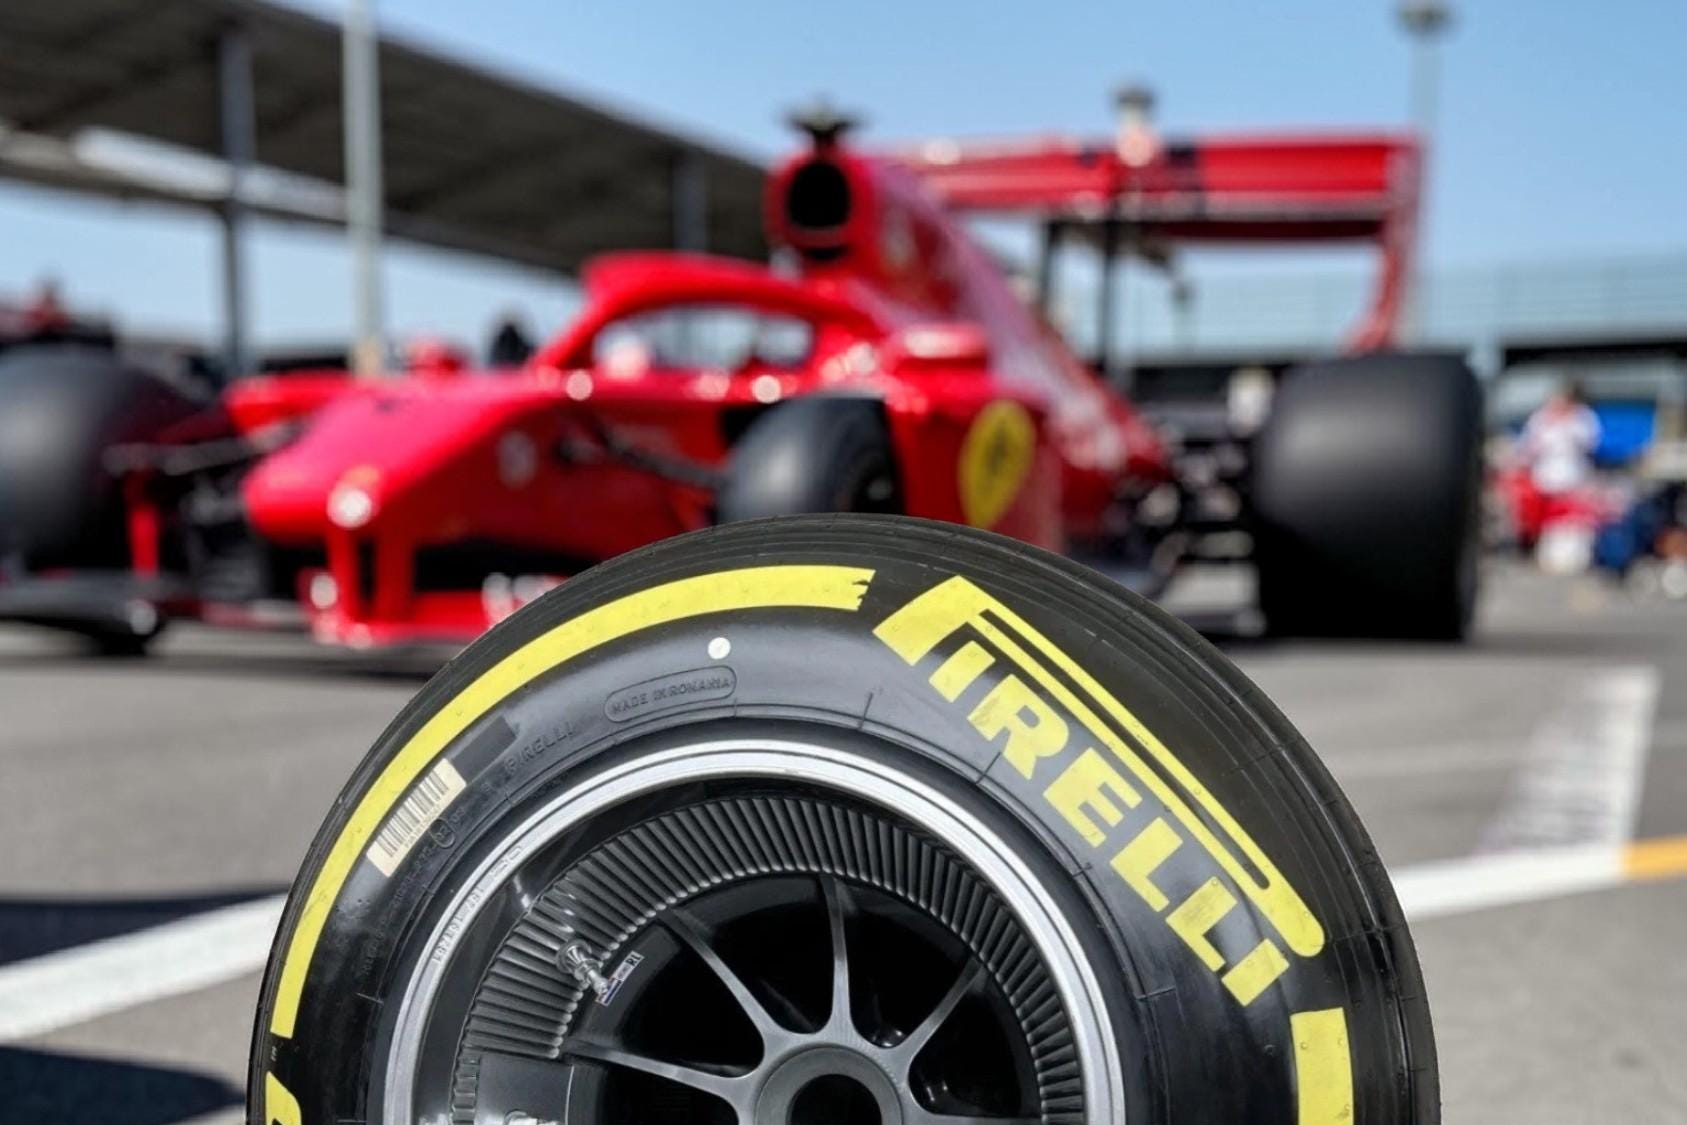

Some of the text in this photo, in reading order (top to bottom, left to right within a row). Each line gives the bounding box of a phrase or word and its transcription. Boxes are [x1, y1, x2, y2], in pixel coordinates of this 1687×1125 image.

[611, 691, 649, 714] MADE
[502, 722, 574, 773] PIRELLI
[873, 575, 1325, 1006] PIRELLI
